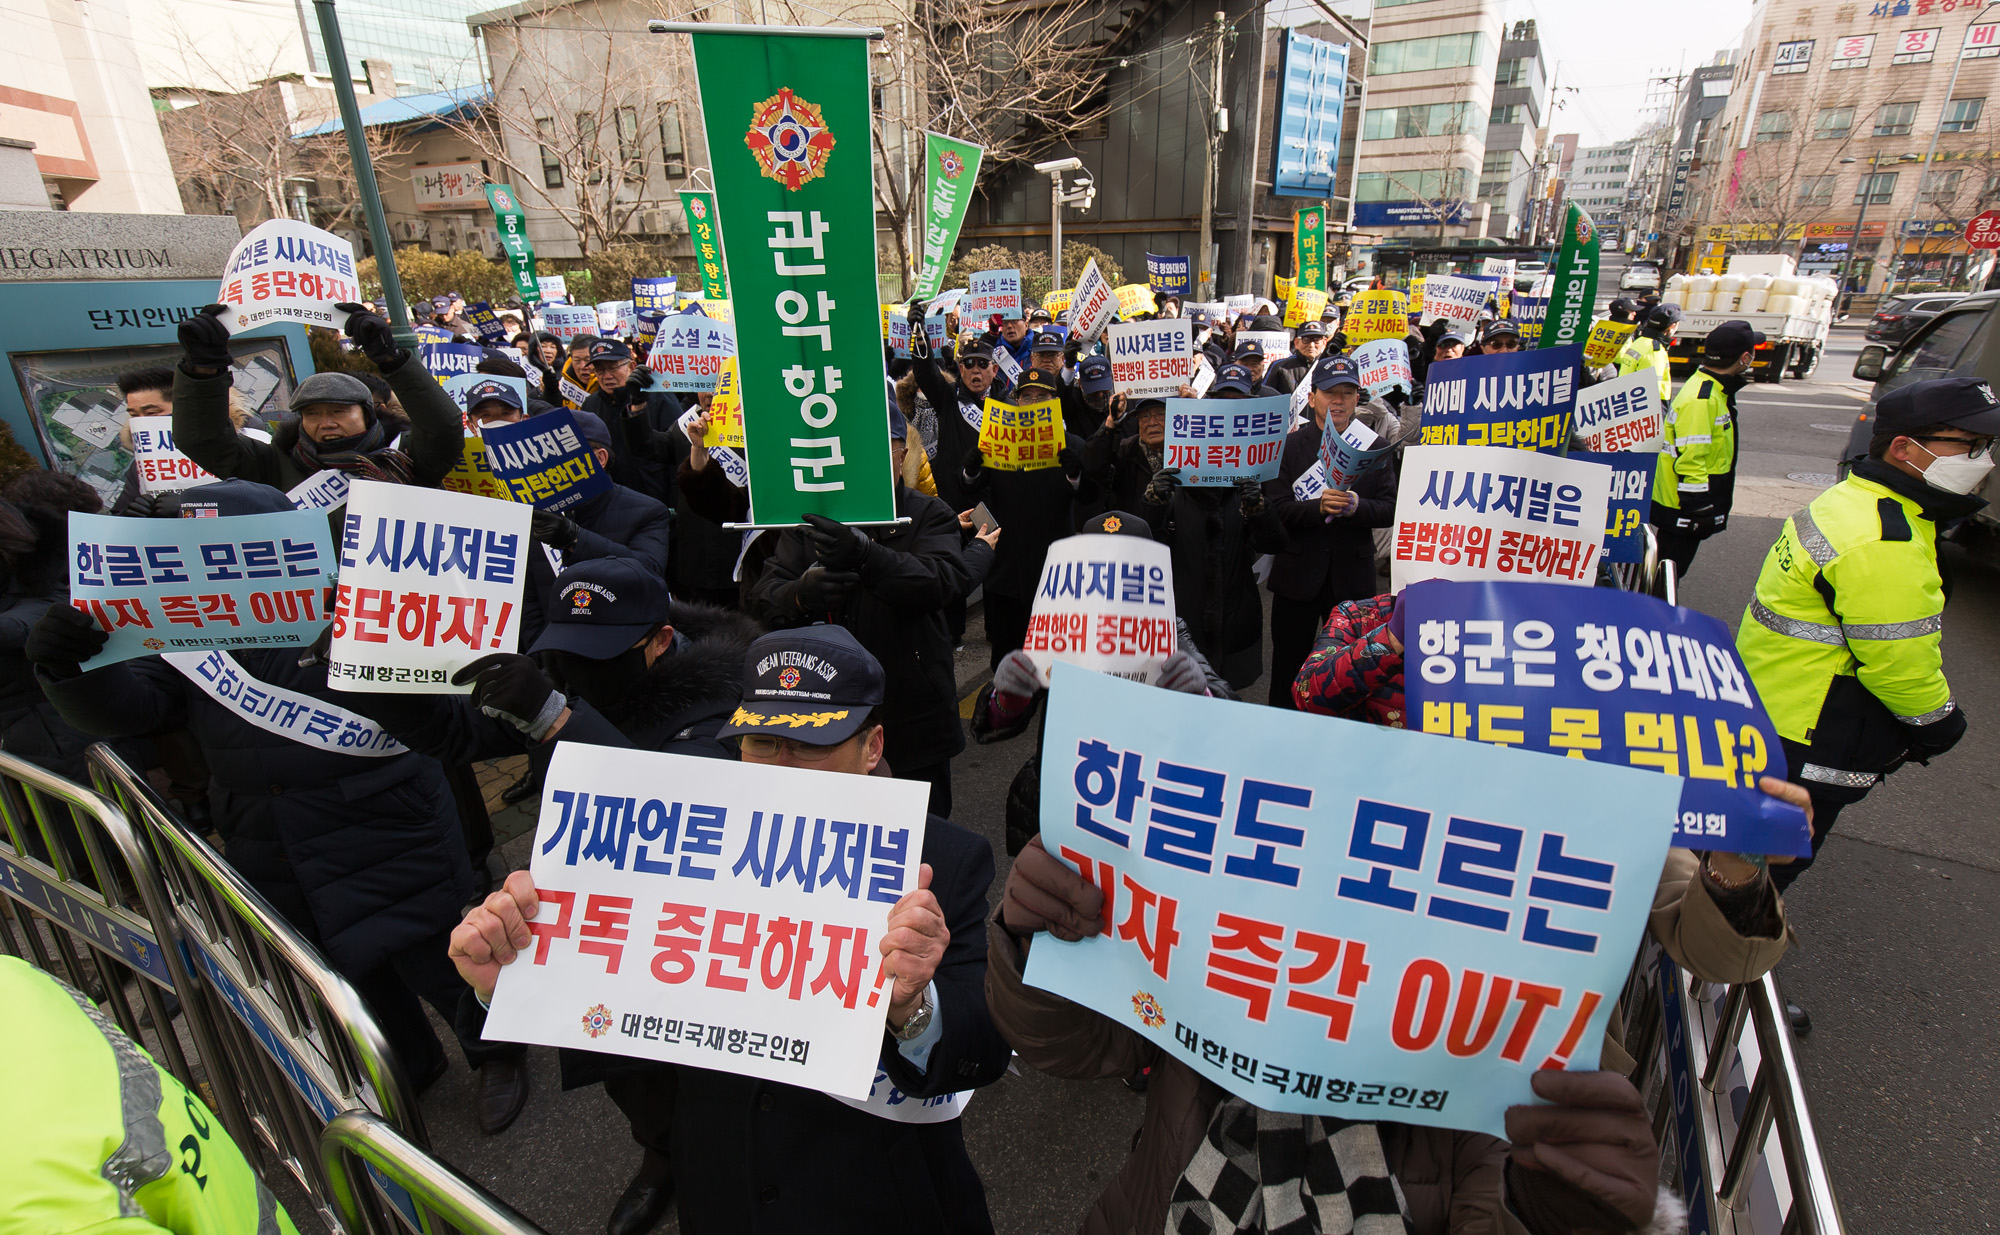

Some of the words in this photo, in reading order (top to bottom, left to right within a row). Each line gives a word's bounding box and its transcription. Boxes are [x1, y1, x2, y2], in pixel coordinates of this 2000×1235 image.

[1843, 38, 1865, 57] 중
[1906, 32, 1929, 52] 장
[1972, 25, 1997, 45] 비
[0, 248, 173, 269] EGATRIUM
[275, 237, 353, 278] 시사저널
[696, 223, 722, 298] 강동향군
[1159, 261, 1187, 274] 청와대와
[1302, 236, 1321, 291] 마포향
[251, 271, 356, 304] 중단하자!
[634, 283, 655, 295] 향군은
[981, 279, 996, 292] 소설
[1000, 278, 1017, 291] 쓰는
[1078, 269, 1101, 303] 시사저널
[1165, 276, 1187, 287] 먹냐?
[1449, 286, 1486, 305] 시사저널
[1555, 249, 1590, 345] 노원향
[250, 308, 332, 322] 대한민국재향군인회
[545, 313, 571, 324] 한글도
[572, 312, 594, 323] 모르는
[635, 297, 651, 308] 밥도
[988, 295, 1020, 309] 각성하라!
[1078, 282, 1110, 332] 중단하자!
[1368, 299, 1389, 315] 갑질
[1434, 302, 1480, 322] 중단하자!
[671, 328, 700, 349] 소설
[707, 330, 734, 353] 쓰는
[890, 337, 904, 350] 기자
[1115, 331, 1185, 357] 시사저널은
[1363, 318, 1409, 335] 수사하라!
[1594, 327, 1615, 343] 언론
[430, 353, 480, 373] 시사저널
[766, 210, 846, 493] 관악향군
[1113, 357, 1145, 382] 불법행위
[1147, 355, 1193, 379] 중단하라!
[1375, 348, 1398, 364] 소설
[1424, 379, 1467, 416] 사이비
[1473, 366, 1573, 412] 시사저널
[986, 424, 1054, 444] 시사저널
[989, 405, 1052, 427] 본분망각
[1173, 413, 1225, 440] 한글도
[1232, 411, 1283, 438] 모르는
[1467, 412, 1572, 452] 규탄한다!
[1604, 413, 1660, 452] 중단하라!
[498, 424, 582, 470] 시사저널
[1168, 445, 1200, 469] 기자
[1206, 445, 1242, 469] 즉각
[1247, 440, 1281, 466] OUT!
[143, 458, 218, 482] 중단하
[510, 453, 596, 504] 규탄한다!
[1418, 470, 1583, 527] 시사저널은
[76, 541, 190, 587] 한글도
[200, 538, 321, 582] 모르는
[367, 517, 518, 584] 시사저널
[1396, 521, 1492, 569] 불법행위
[1497, 530, 1597, 581] 중단하라!
[1041, 560, 1166, 605] 시사저널은
[160, 593, 241, 629] 즉각
[250, 587, 333, 625] OUT!
[333, 584, 513, 650] 중단하자!
[169, 634, 301, 647] 대한민국재향군인회
[1096, 614, 1177, 659] 중단하라!
[756, 652, 779, 677] KOREAN
[779, 651, 818, 670] VETERANS
[814, 660, 838, 682] ASSN
[1419, 620, 1556, 688] 향군은
[1575, 622, 1754, 709] 청와대와
[1624, 711, 1769, 790] 먹냐?
[542, 790, 727, 881] 가짜언론
[732, 810, 909, 904] 시사저널
[1072, 738, 1314, 888] 한글도
[1336, 797, 1616, 954] 모르는
[41, 885, 123, 949] LINE
[527, 888, 633, 974] 구독
[650, 901, 889, 1009] 중단하자!
[1205, 912, 1370, 1043] 즉각
[1389, 957, 1604, 1070] OUT!
[621, 1012, 811, 1065] 대한민국재향군인회
[1174, 1020, 1449, 1113] 대한민국재향군인회
[179, 1088, 210, 1193] PO
[1671, 1023, 1709, 1235] POLI
